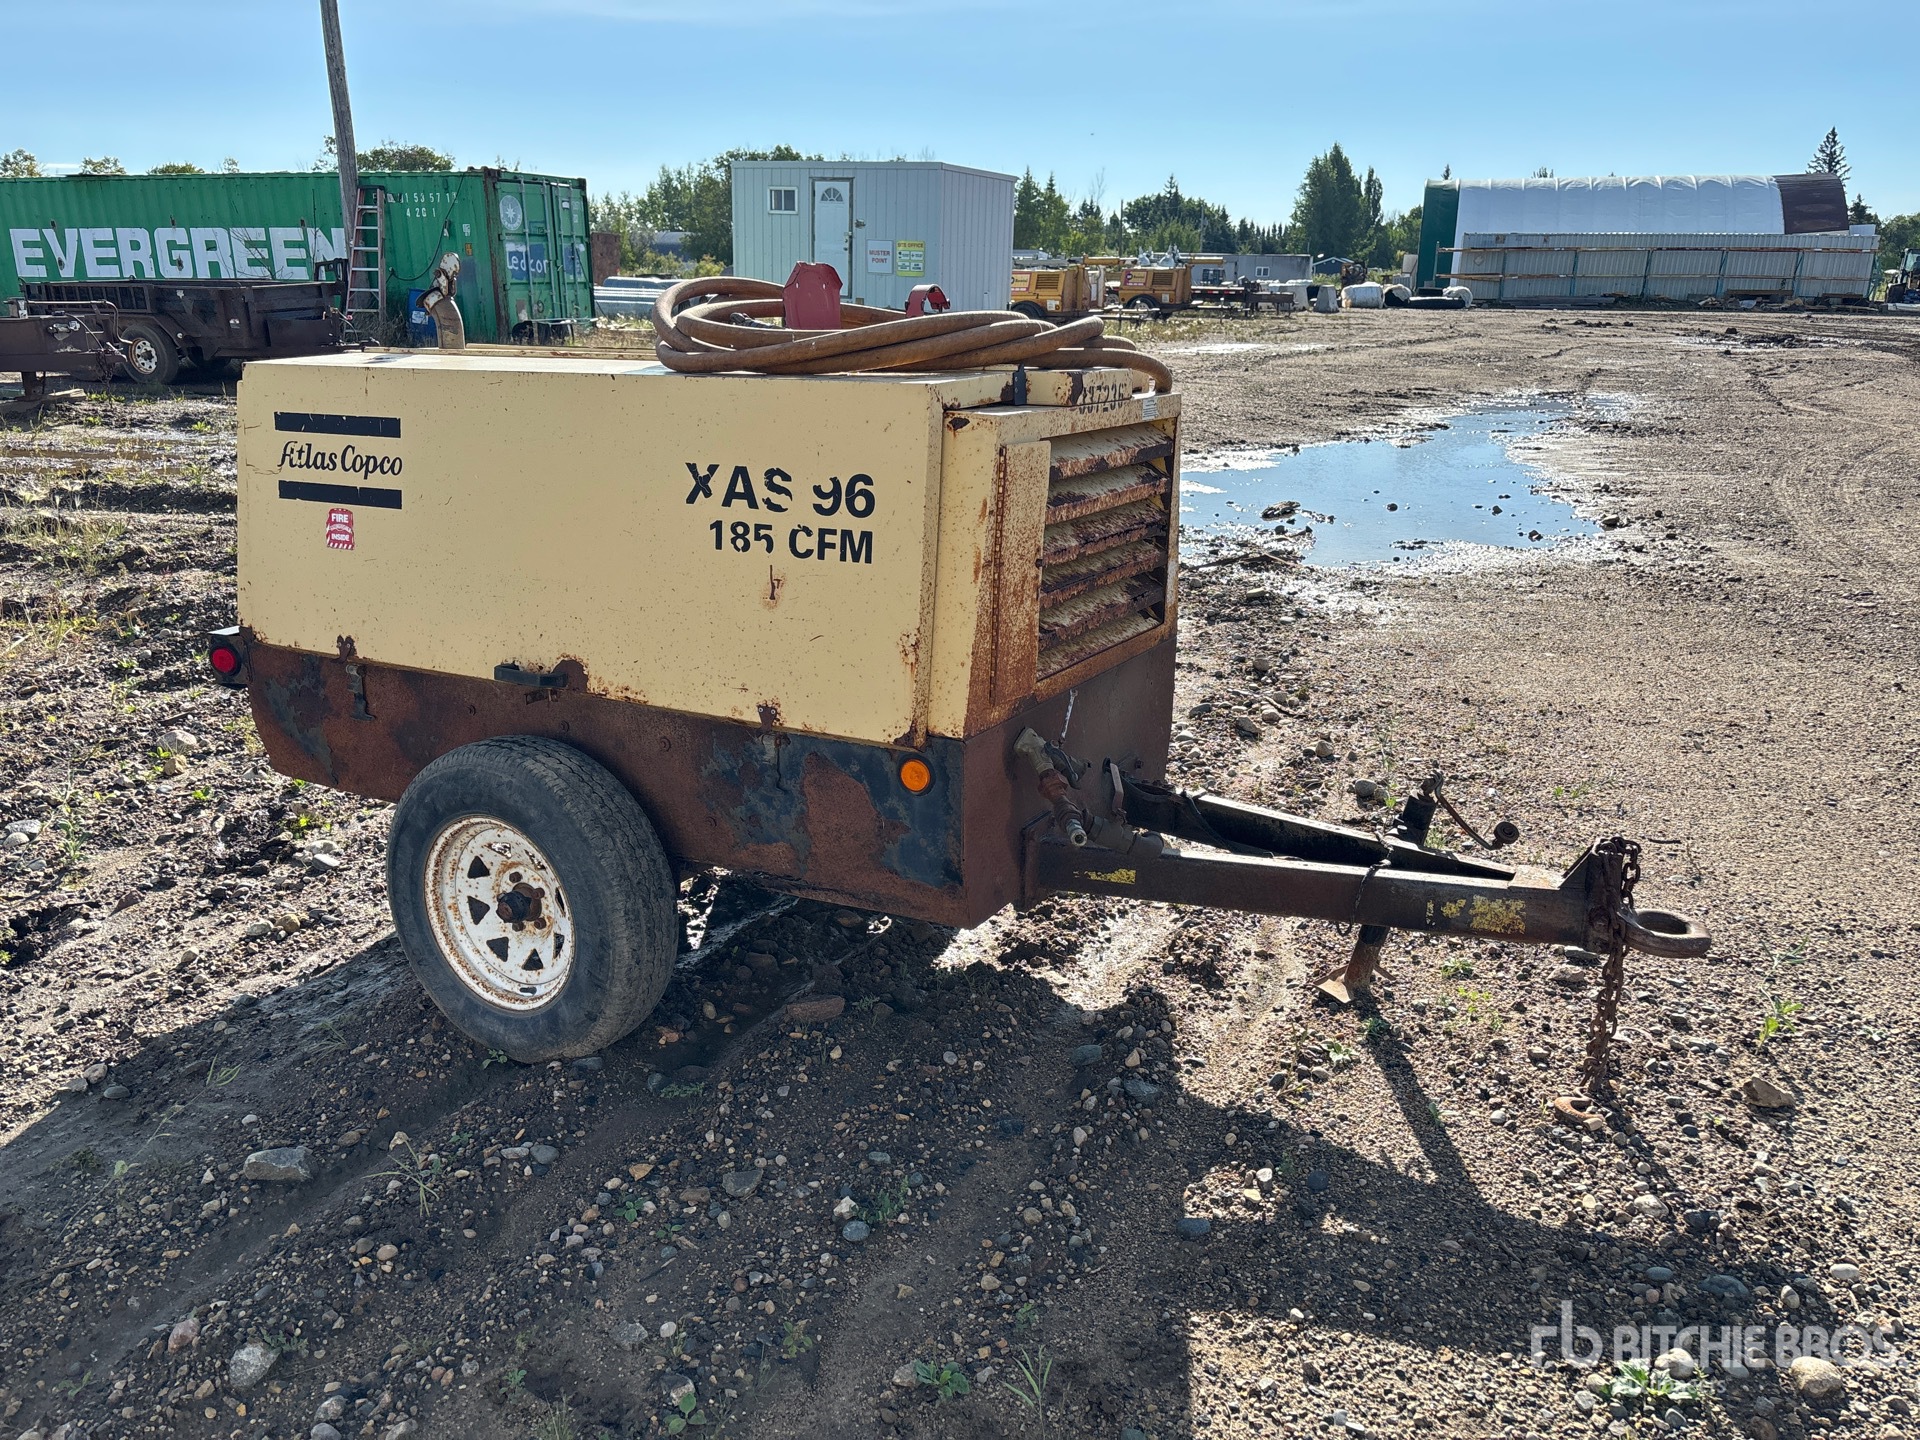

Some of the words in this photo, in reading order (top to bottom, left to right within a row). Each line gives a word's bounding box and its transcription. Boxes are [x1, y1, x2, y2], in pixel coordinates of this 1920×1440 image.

[9, 227, 347, 281] EVERGREEN
[869, 249, 890, 257] MUSTER
[277, 440, 338, 472] Atlas
[340, 444, 403, 480] Copco
[685, 462, 793, 512] XAS
[812, 473, 876, 518] 96
[331, 513, 349, 524] FIRE
[331, 533, 350, 542] INSIDE
[709, 520, 774, 554] 185
[788, 524, 873, 564] CFM
